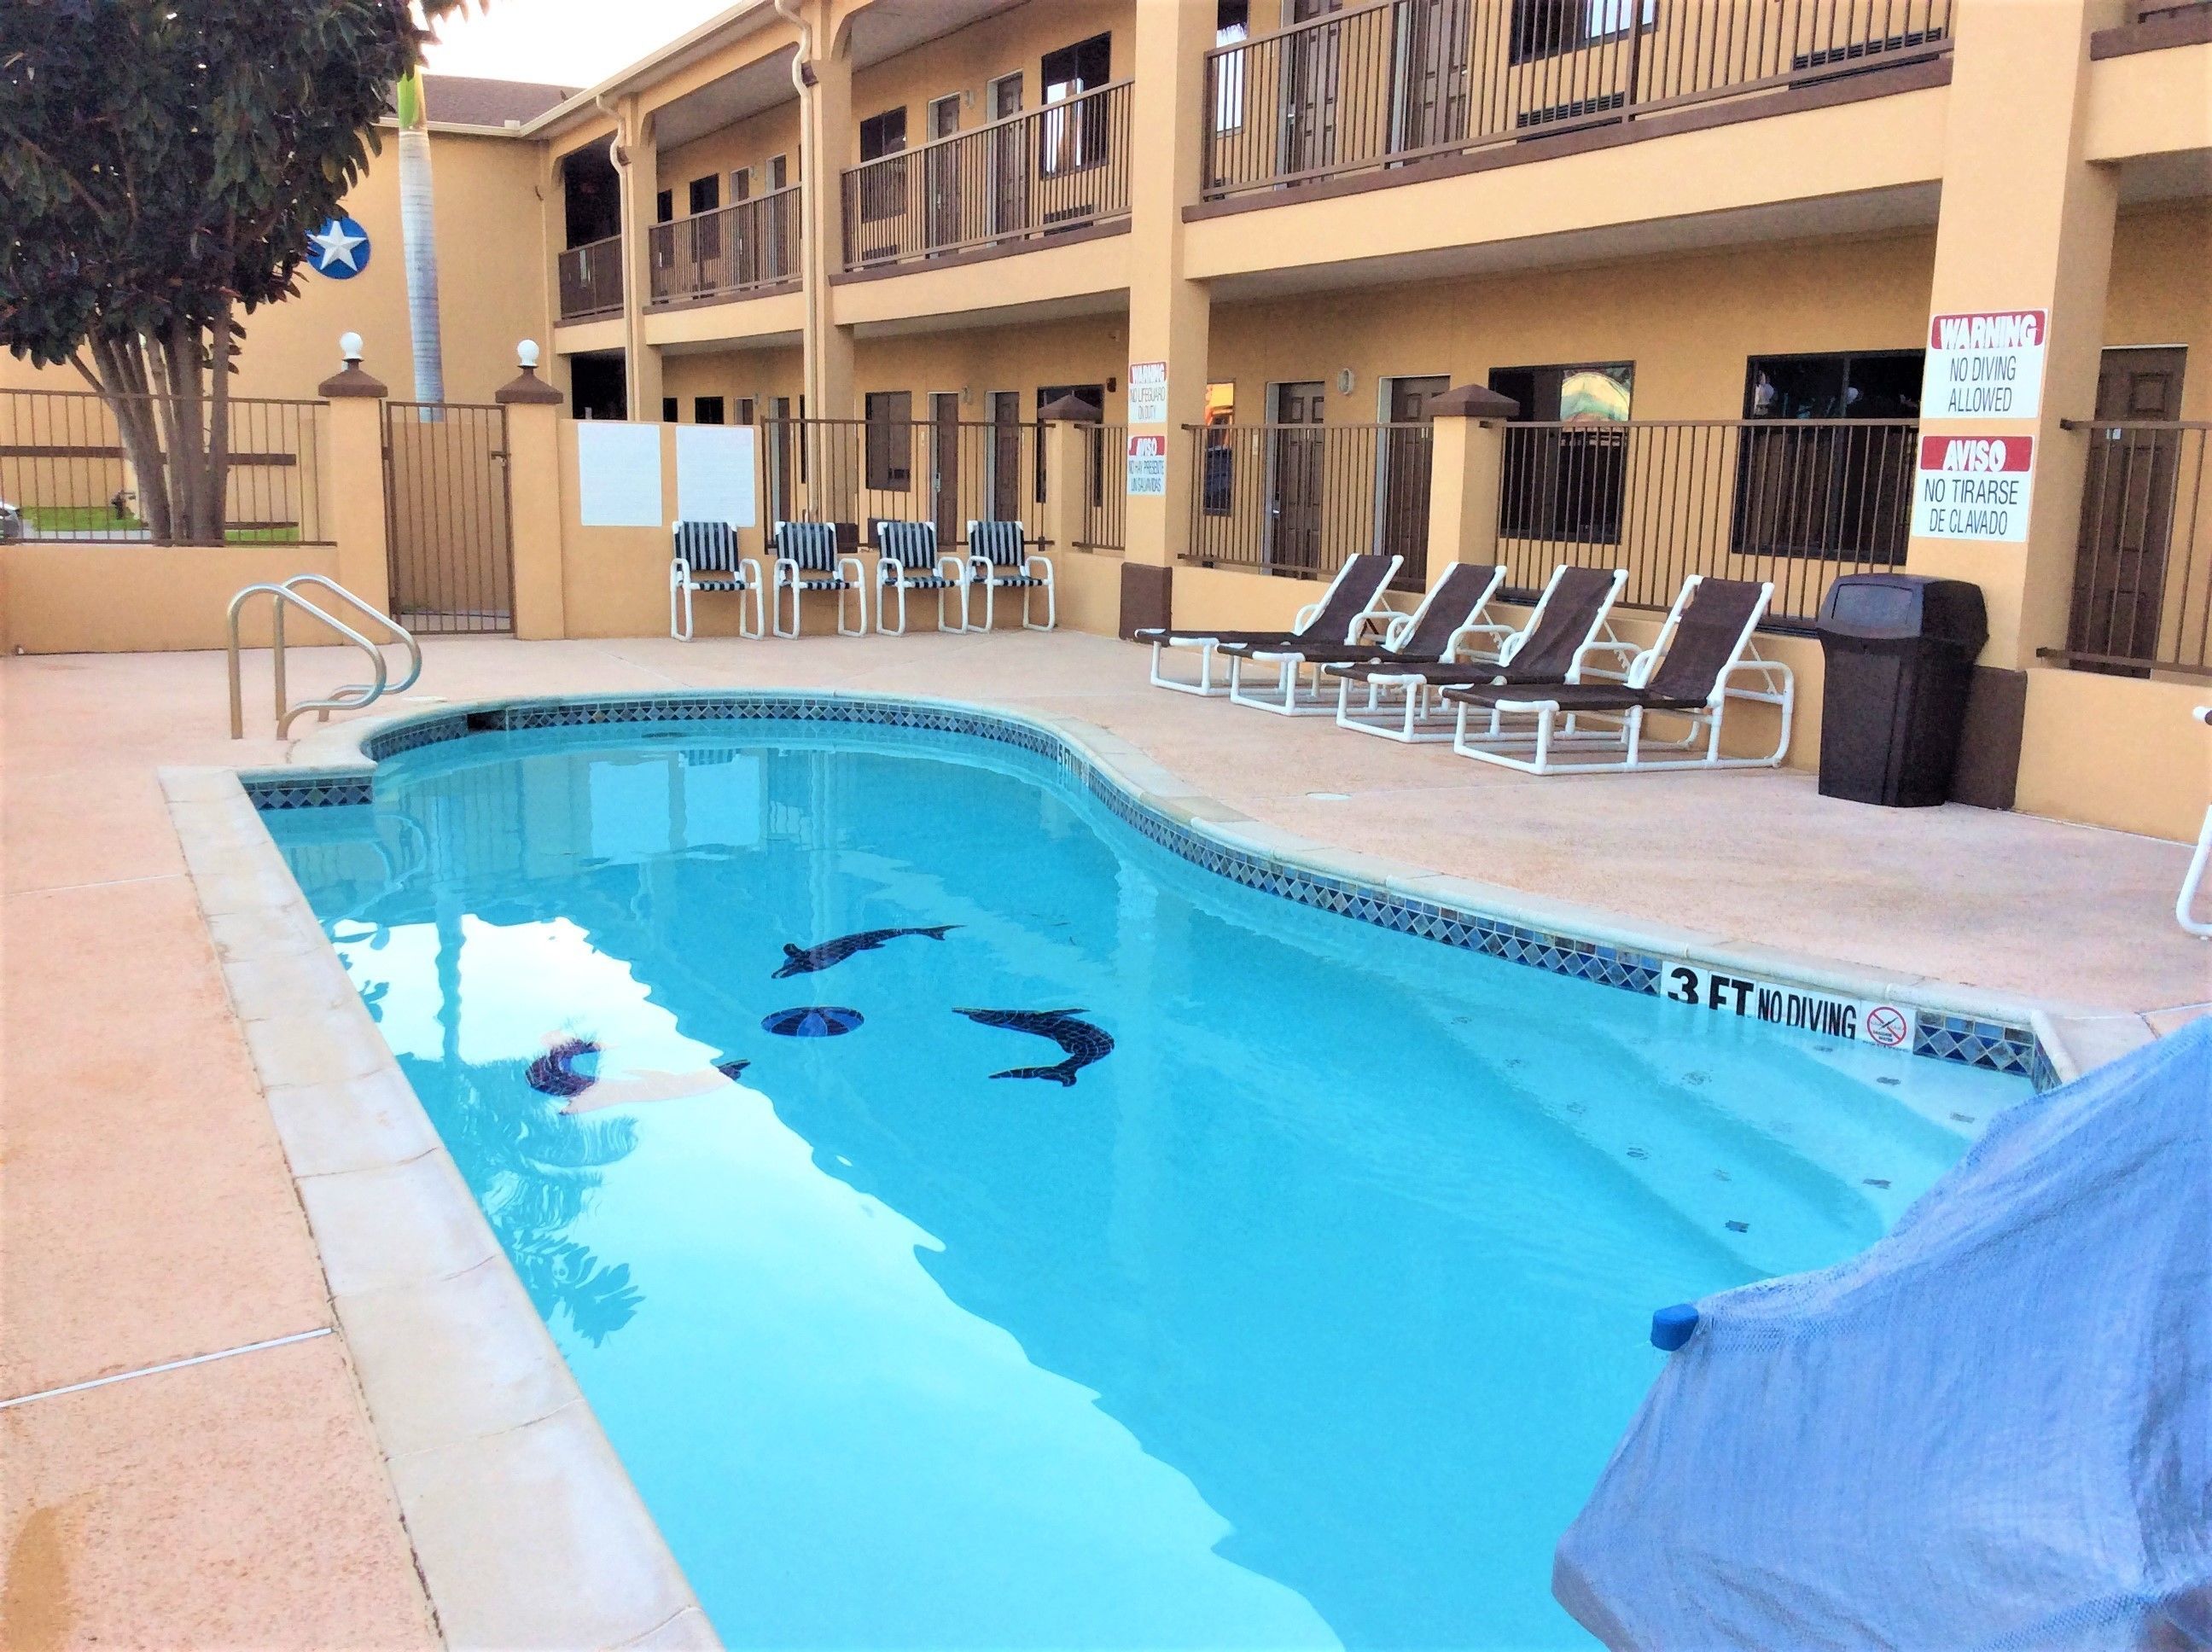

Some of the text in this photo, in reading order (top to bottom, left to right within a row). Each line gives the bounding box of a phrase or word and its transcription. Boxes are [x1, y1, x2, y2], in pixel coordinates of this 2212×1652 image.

[1940, 314, 2037, 349] WARNING
[1949, 355, 2017, 382] NO DIVING
[1947, 387, 2013, 412] ALLOWED
[1942, 439, 2007, 472] AVISO
[1924, 478, 2019, 504] NO TIRARSE
[1930, 508, 2008, 535] DE CLAVADO
[1667, 967, 1857, 1040] 3 FT NO DIVING
